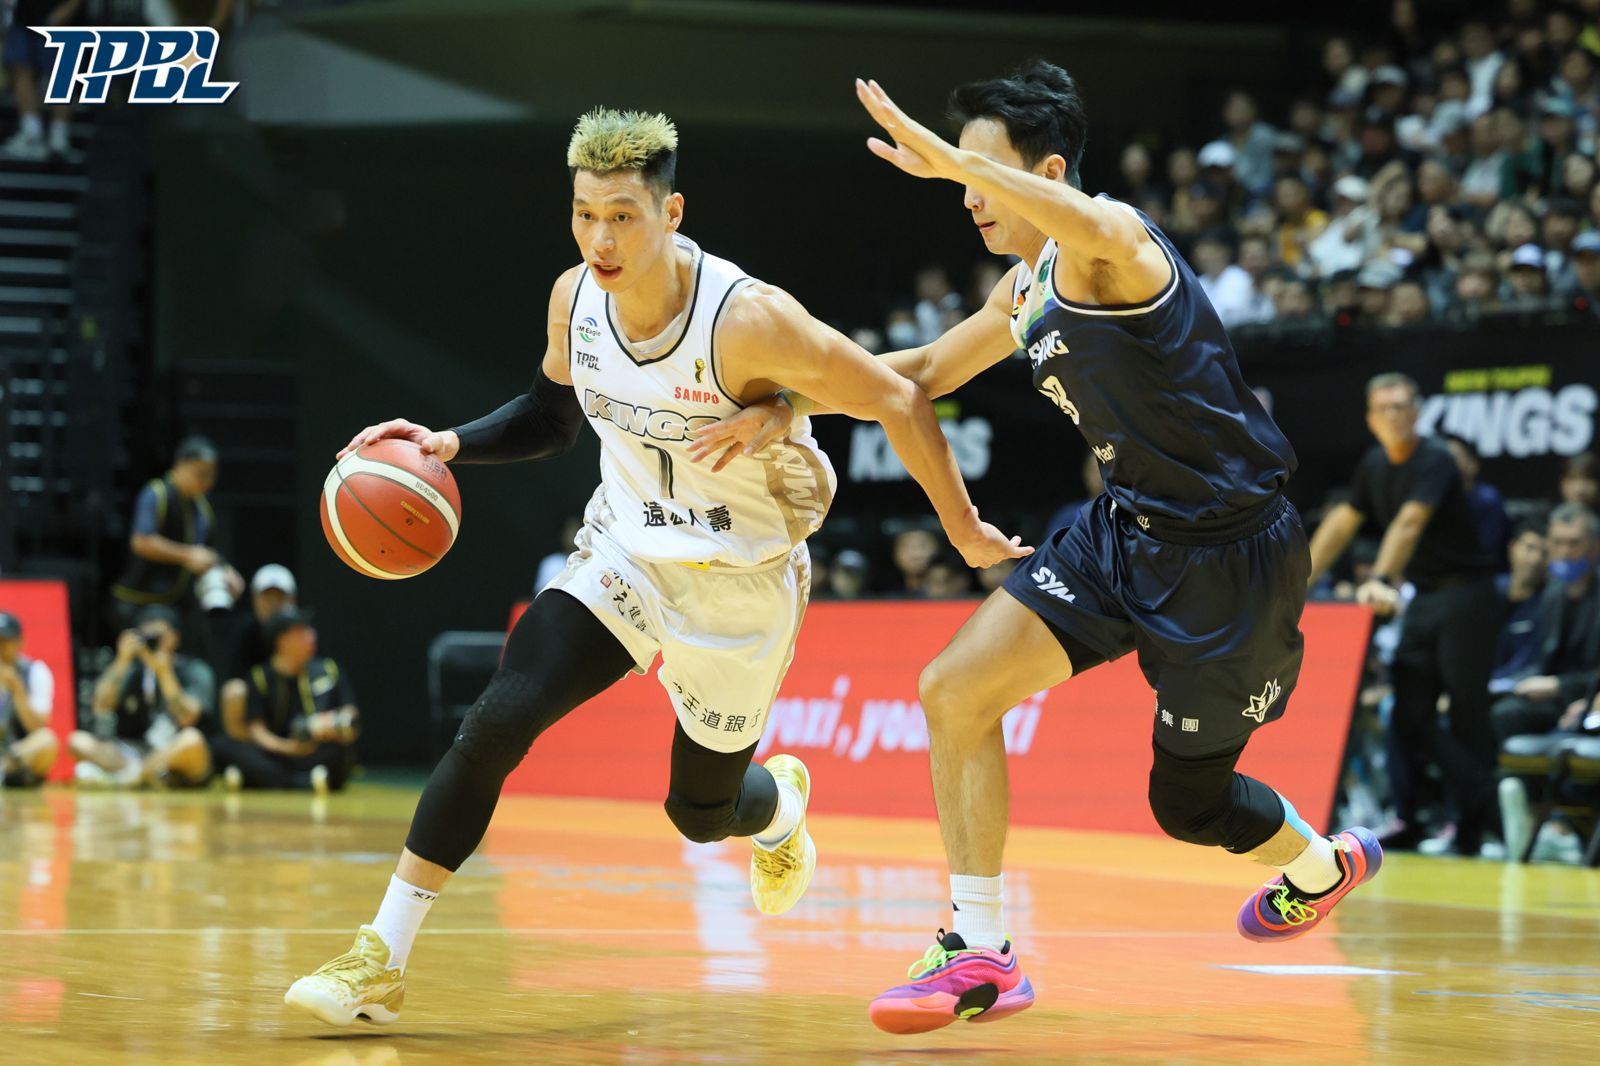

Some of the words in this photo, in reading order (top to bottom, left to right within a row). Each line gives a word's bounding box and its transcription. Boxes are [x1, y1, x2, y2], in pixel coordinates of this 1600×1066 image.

[576, 350, 601, 371] TPBL
[674, 386, 720, 405] SAMPO
[1031, 566, 1076, 604] SYM
